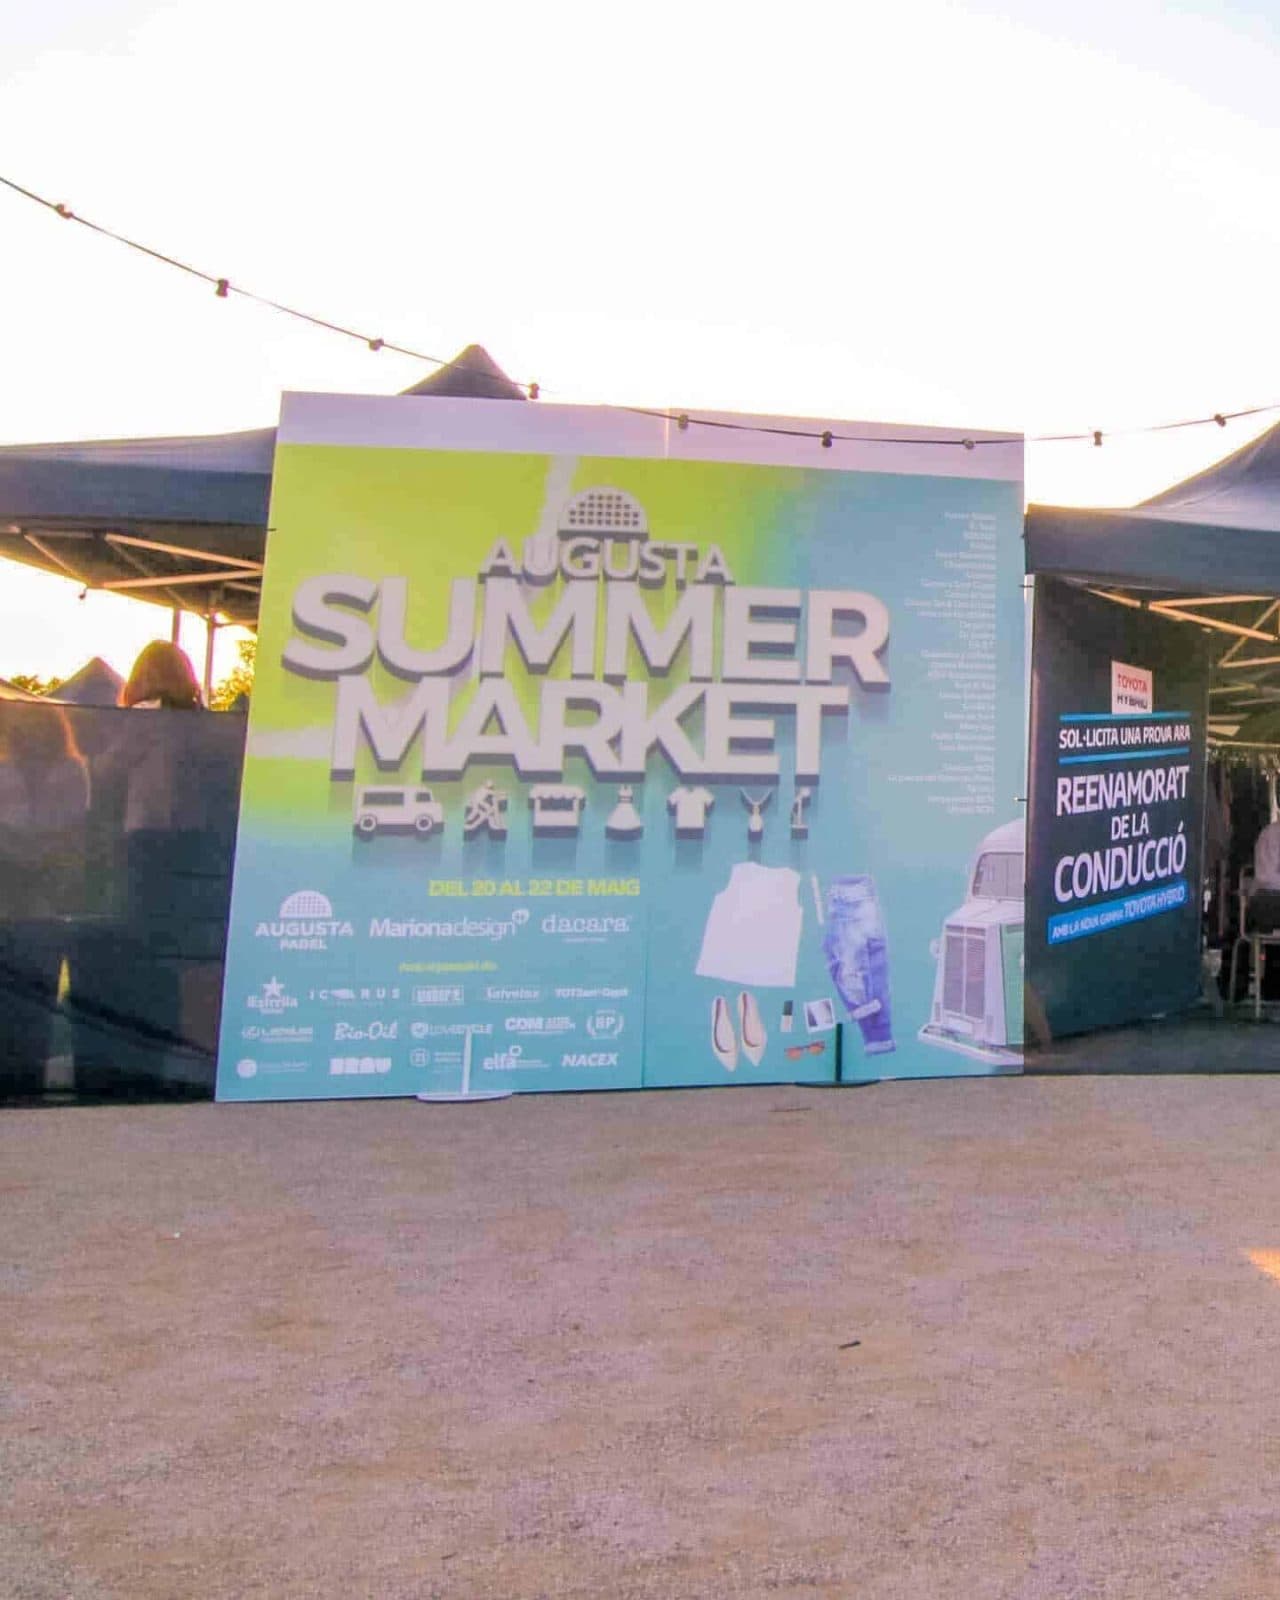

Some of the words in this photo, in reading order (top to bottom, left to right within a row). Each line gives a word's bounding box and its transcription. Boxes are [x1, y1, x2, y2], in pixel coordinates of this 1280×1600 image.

[481, 536, 735, 588] AUGUSTA
[282, 572, 891, 693] SUMMER
[1117, 673, 1148, 693] TOYOTA
[330, 674, 850, 783] MARKET
[1120, 726, 1142, 745] UNA
[1143, 725, 1173, 744] PROVA
[1173, 724, 1191, 741] ARA
[1056, 765, 1190, 817] REENAMORA'T
[1111, 814, 1129, 841] DE
[1131, 811, 1149, 837] LA
[1054, 821, 1187, 904] CONDUCCIÓ
[428, 879, 469, 897] DEL
[499, 879, 523, 897] AL
[555, 879, 583, 897] DE
[587, 878, 641, 897] MAIG
[255, 920, 354, 937] AUGUSTA
[561, 1053, 619, 1068] NACEX
